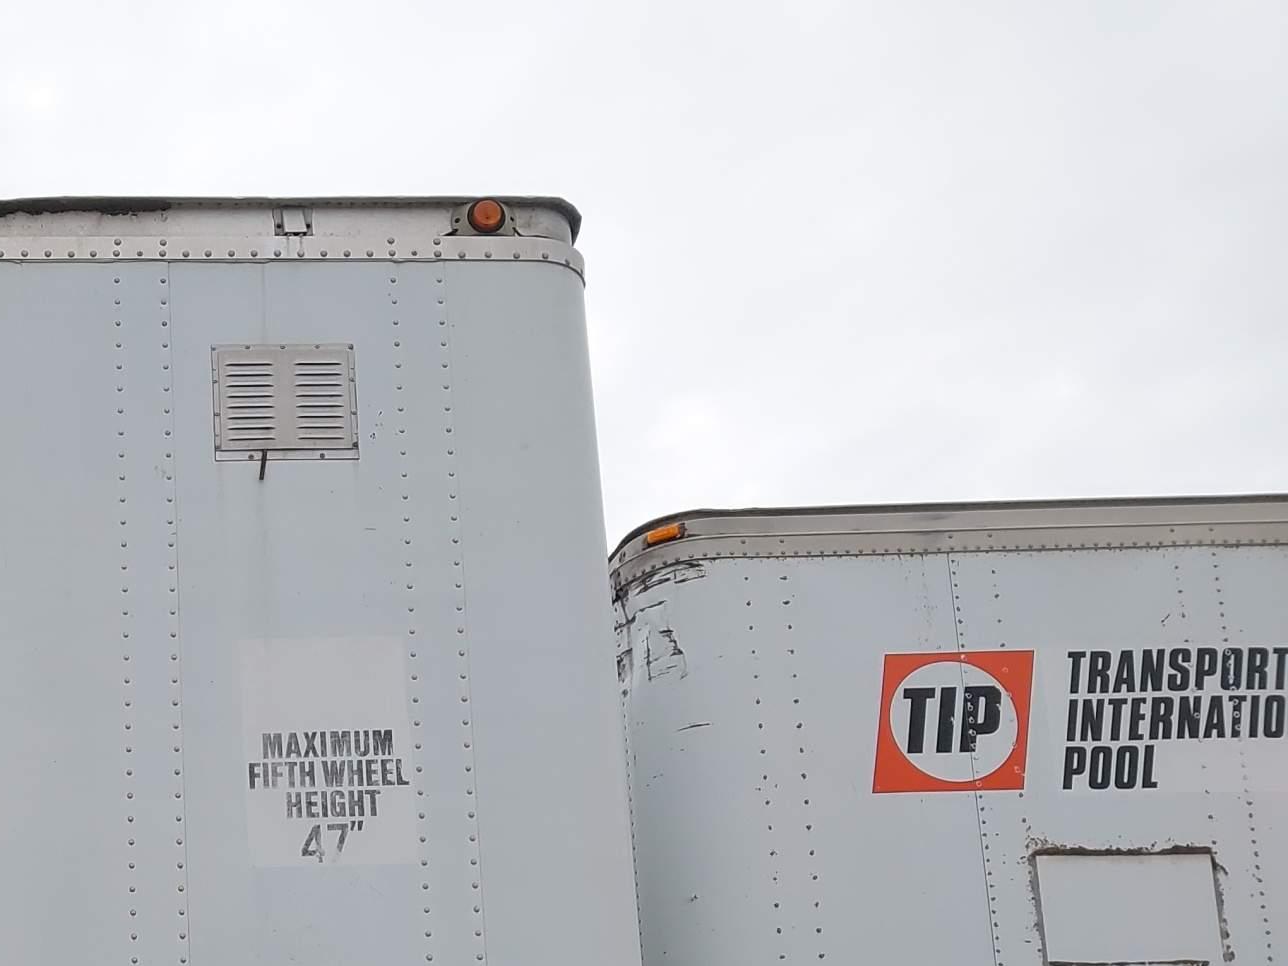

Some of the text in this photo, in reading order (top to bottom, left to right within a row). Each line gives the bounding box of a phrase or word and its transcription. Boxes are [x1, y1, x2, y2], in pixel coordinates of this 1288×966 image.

[1067, 647, 1288, 694] TRANSPORT
[903, 685, 1002, 754] TIP
[1066, 695, 1287, 742] INTERNATIO
[262, 730, 394, 760] MAXIMUM
[248, 759, 410, 790] FIFTH WHEEL
[1062, 745, 1158, 790] POOL
[286, 790, 381, 819] HEIGHT
[301, 820, 364, 864] 47"
